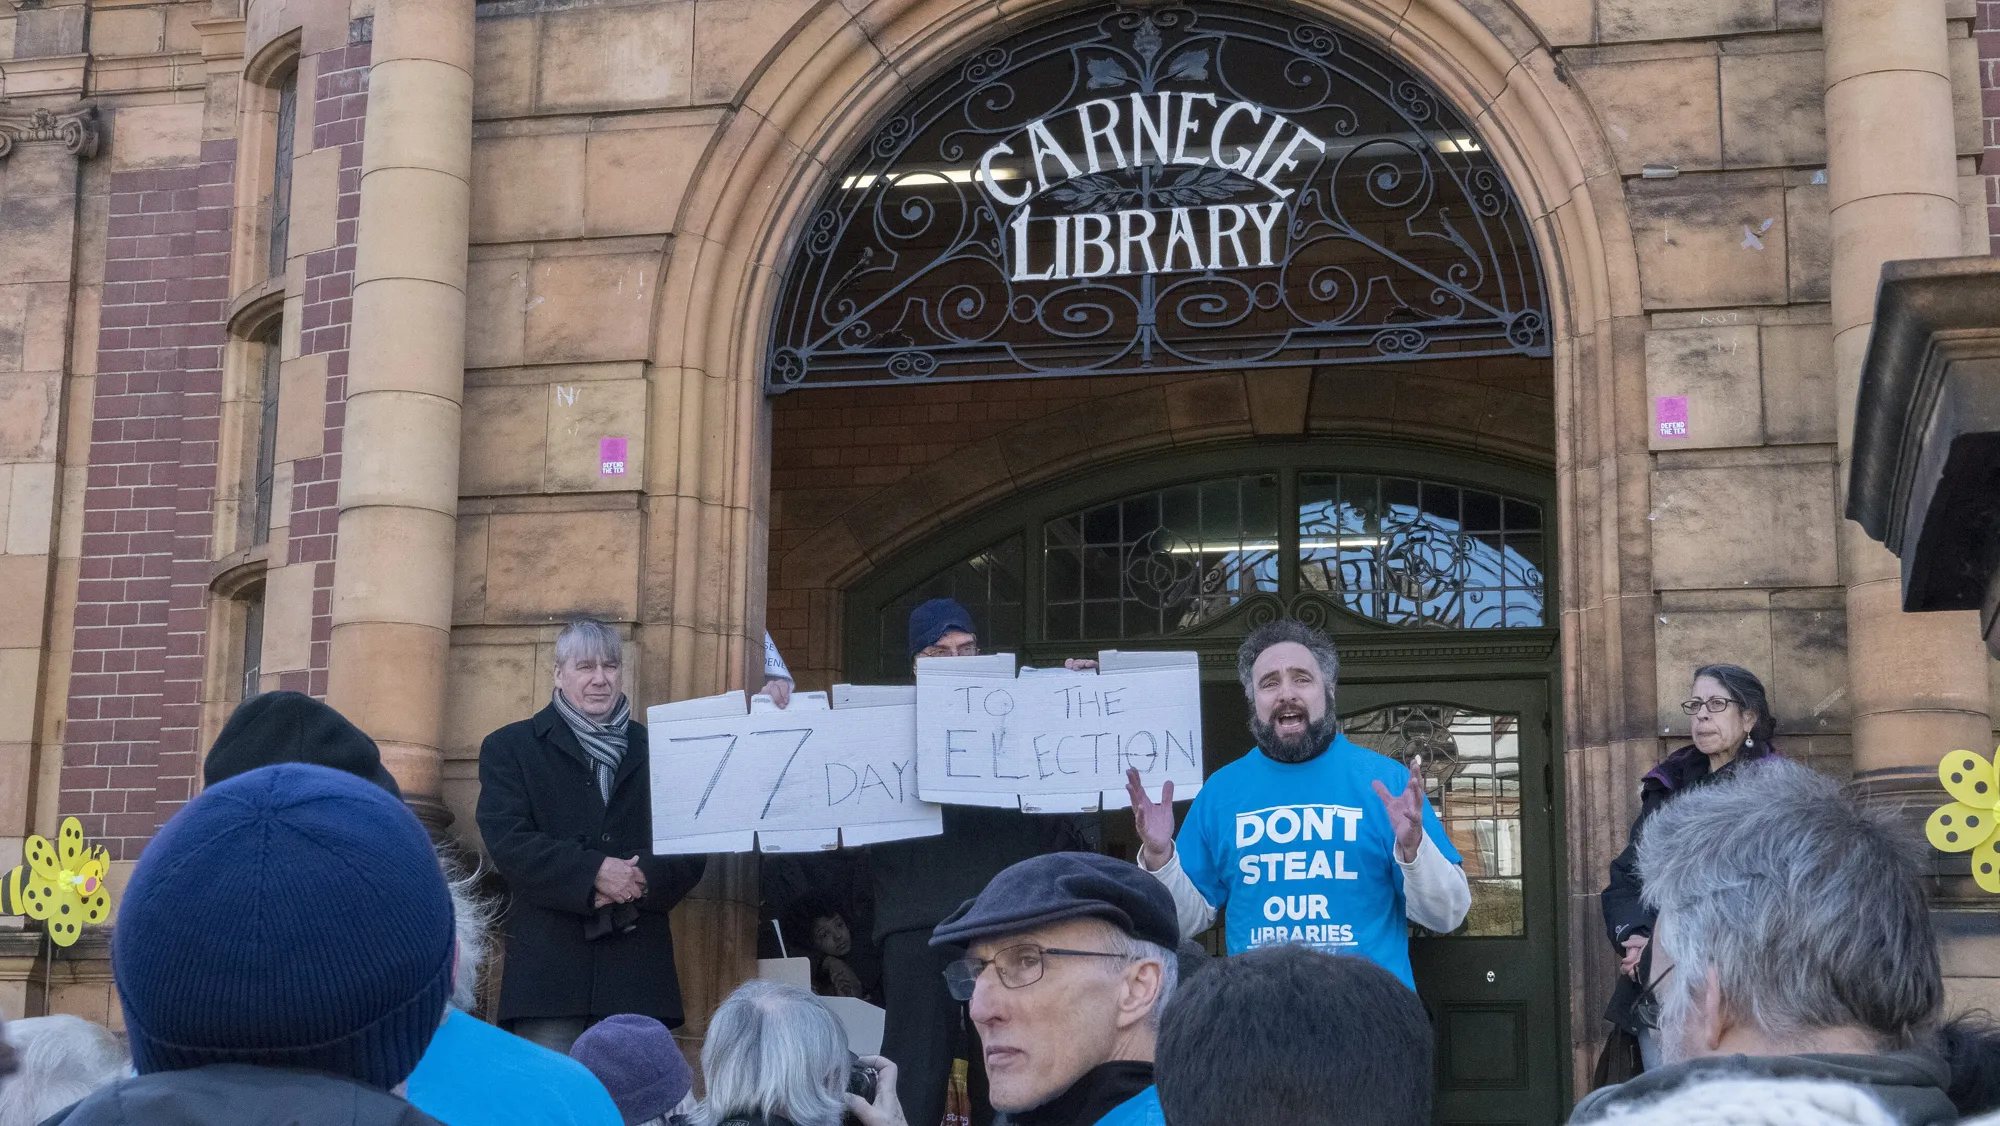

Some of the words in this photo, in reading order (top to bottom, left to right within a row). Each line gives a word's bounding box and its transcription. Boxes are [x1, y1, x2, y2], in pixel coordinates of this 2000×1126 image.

[980, 91, 1326, 206] CARNEGIE
[1010, 201, 1285, 281] LIBRARY
[954, 686, 1014, 716] TO
[1054, 685, 1127, 718] THE
[669, 728, 814, 820] 77
[945, 729, 1196, 781] ELECTION
[1235, 807, 1363, 849] DON'T
[1239, 850, 1359, 885] STEAL
[1263, 894, 1331, 922] OUR
[1250, 924, 1355, 945] LIBRARIES
